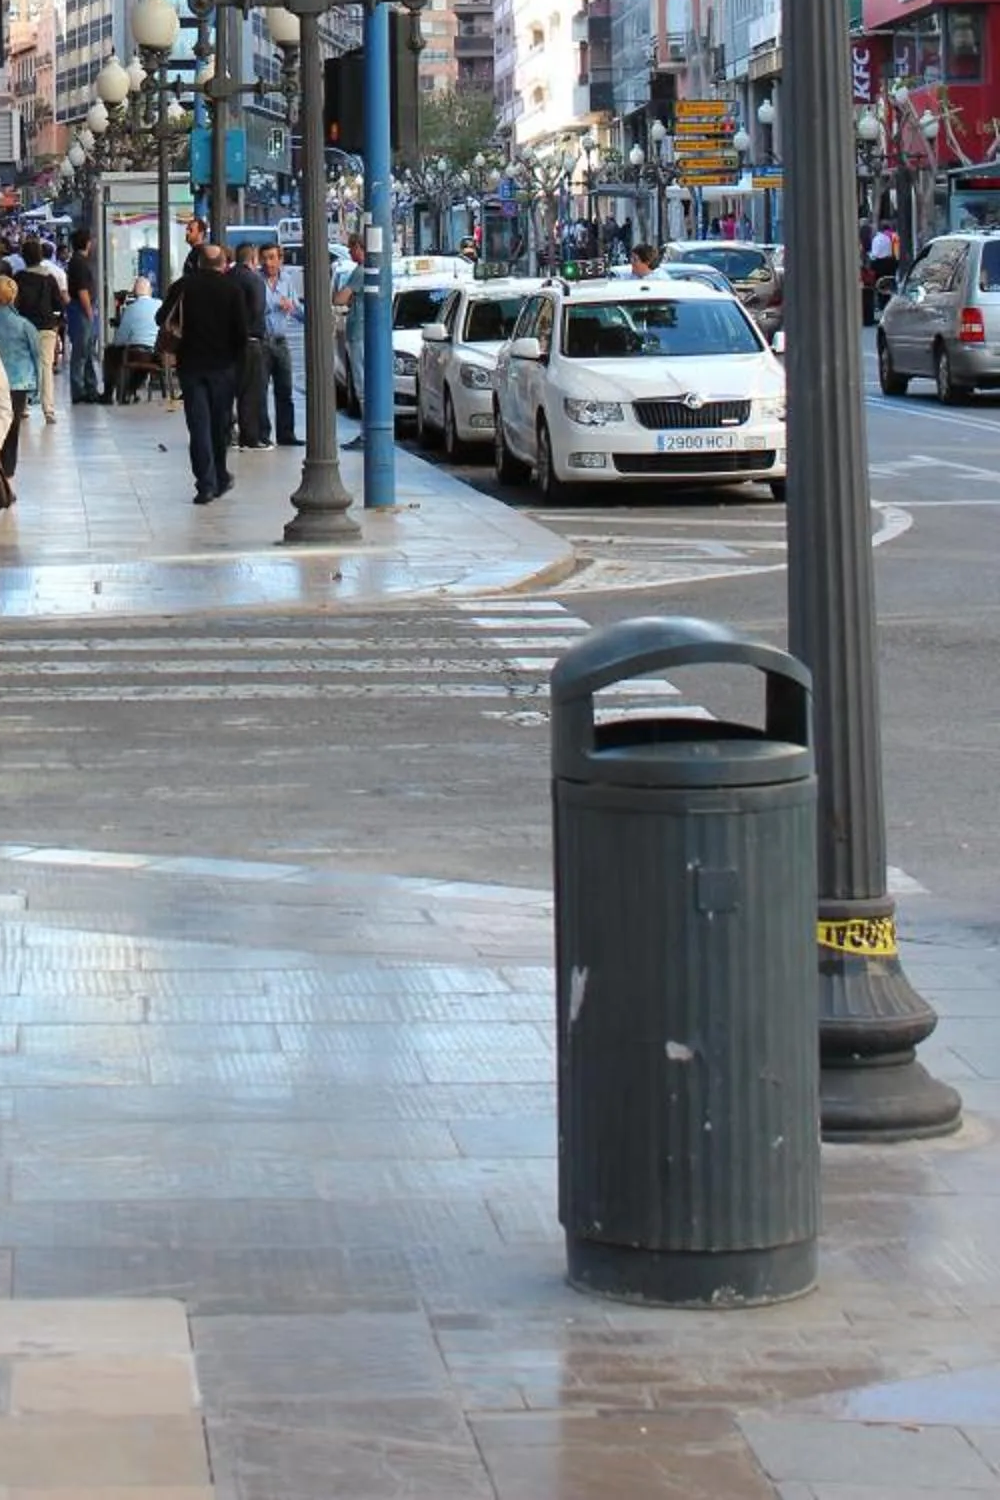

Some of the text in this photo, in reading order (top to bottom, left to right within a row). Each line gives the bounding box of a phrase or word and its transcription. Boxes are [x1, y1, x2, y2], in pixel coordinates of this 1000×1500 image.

[853, 47, 871, 100] KFC
[667, 436, 703, 449] 2900
[707, 435, 733, 448] HCJ
